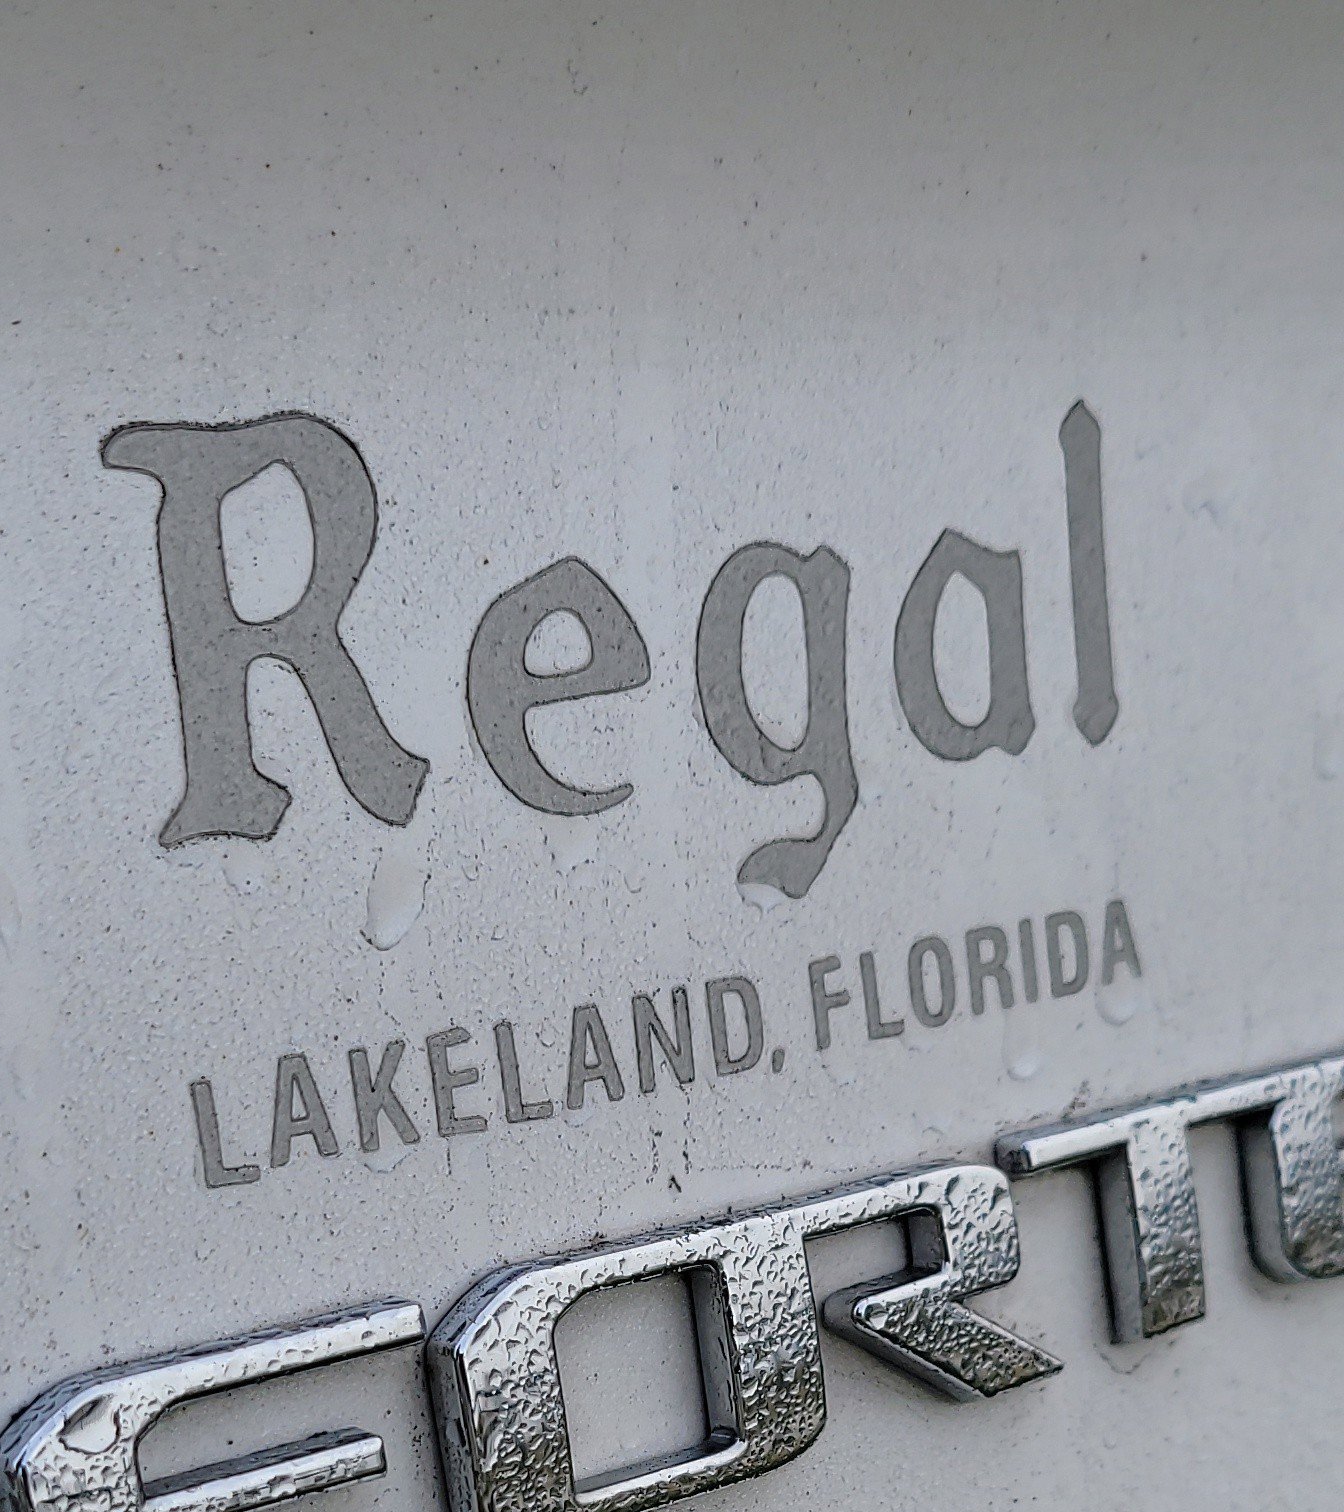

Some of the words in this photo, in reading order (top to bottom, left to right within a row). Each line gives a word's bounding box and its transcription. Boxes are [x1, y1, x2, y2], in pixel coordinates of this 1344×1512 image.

[99, 398, 1122, 898] Regal
[190, 975, 787, 1189] LAKELAND,
[808, 899, 1143, 1050] FLORIDA
